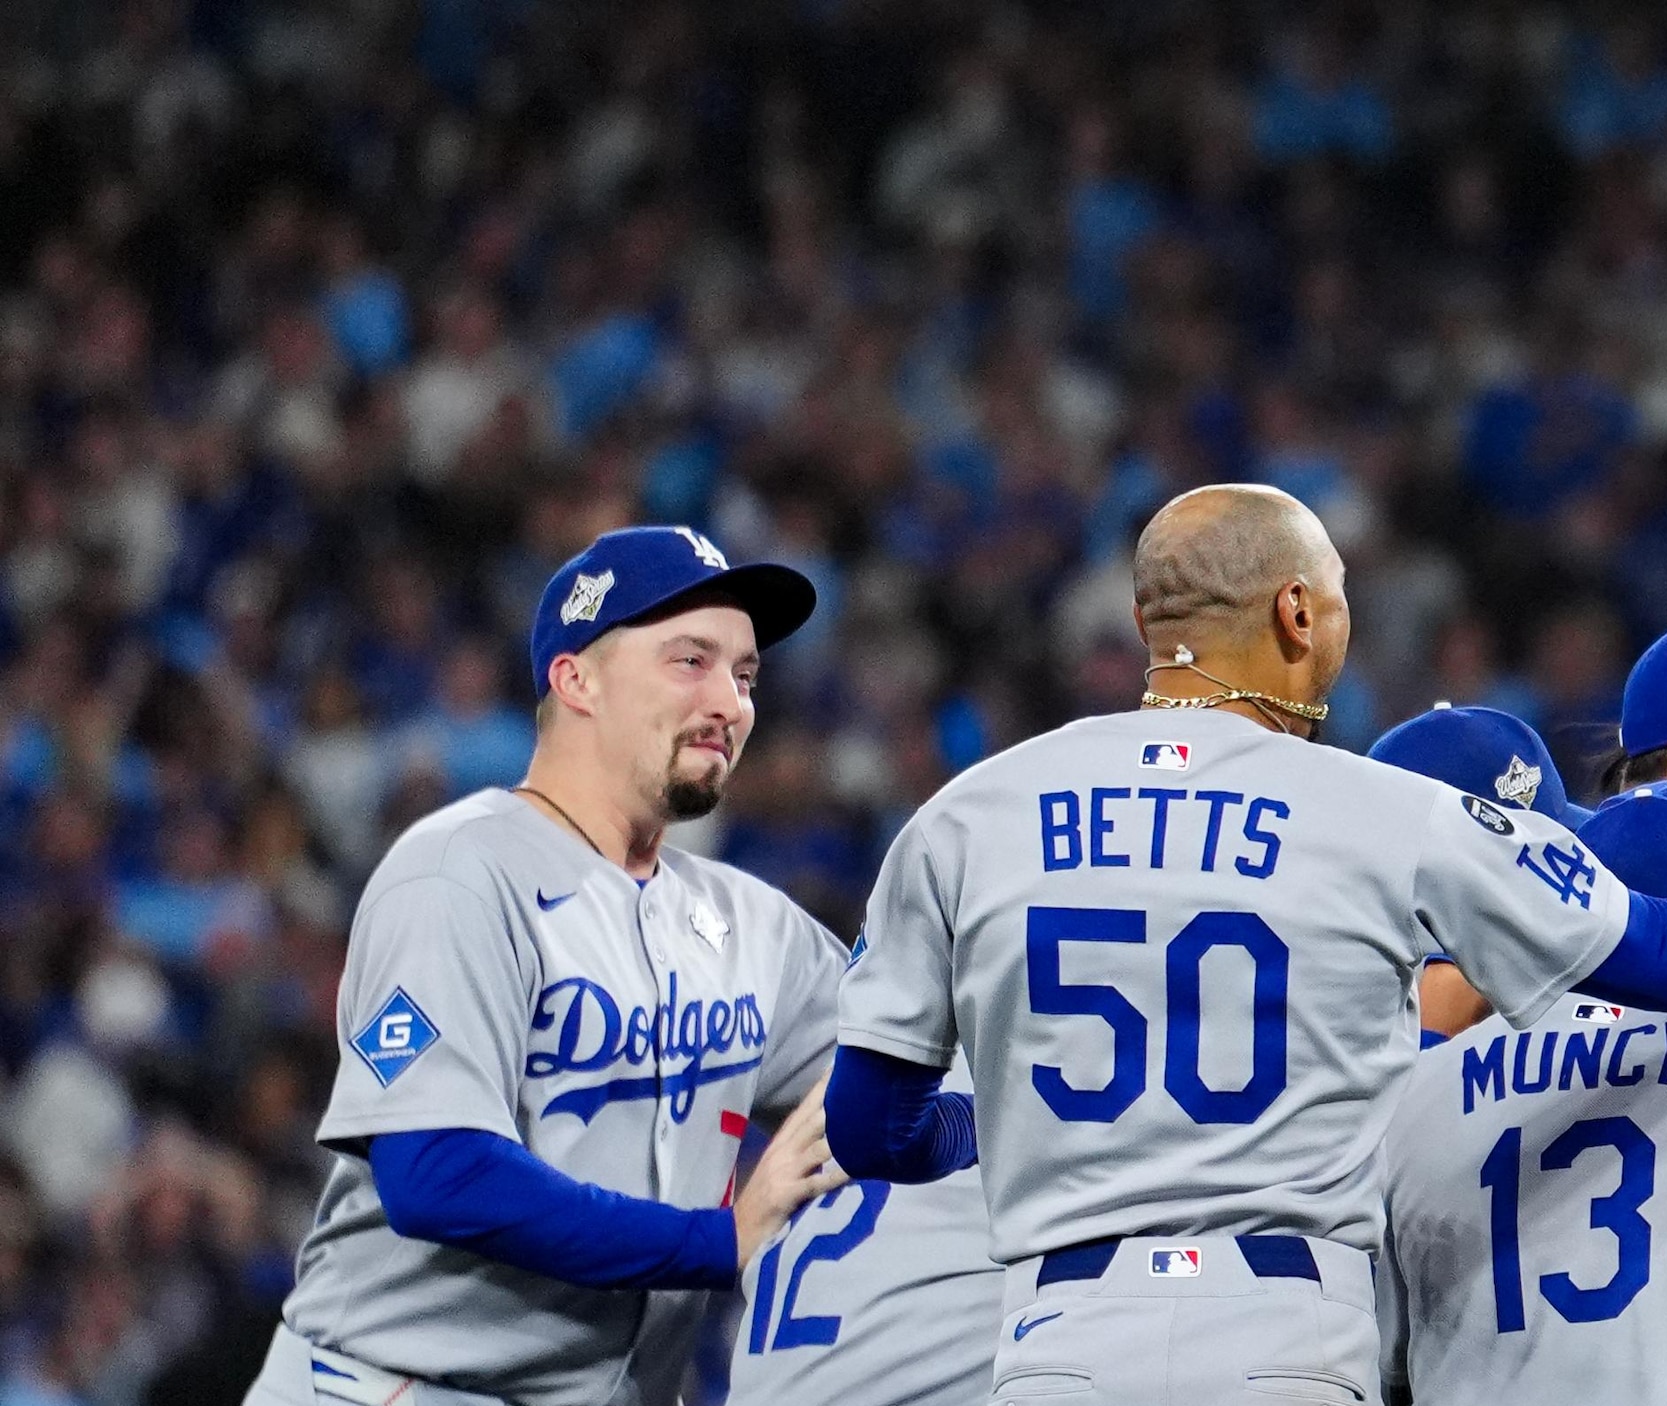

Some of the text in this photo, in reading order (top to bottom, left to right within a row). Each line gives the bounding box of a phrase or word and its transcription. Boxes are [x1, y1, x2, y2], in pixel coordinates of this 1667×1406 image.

[1041, 787, 1290, 878] BETTS
[1516, 842, 1596, 911] LA
[380, 1012, 413, 1048] G
[525, 970, 767, 1125] Dodgers
[1026, 906, 1289, 1124] 50
[748, 1178, 892, 1355] 12
[1480, 1116, 1656, 1334] 13
